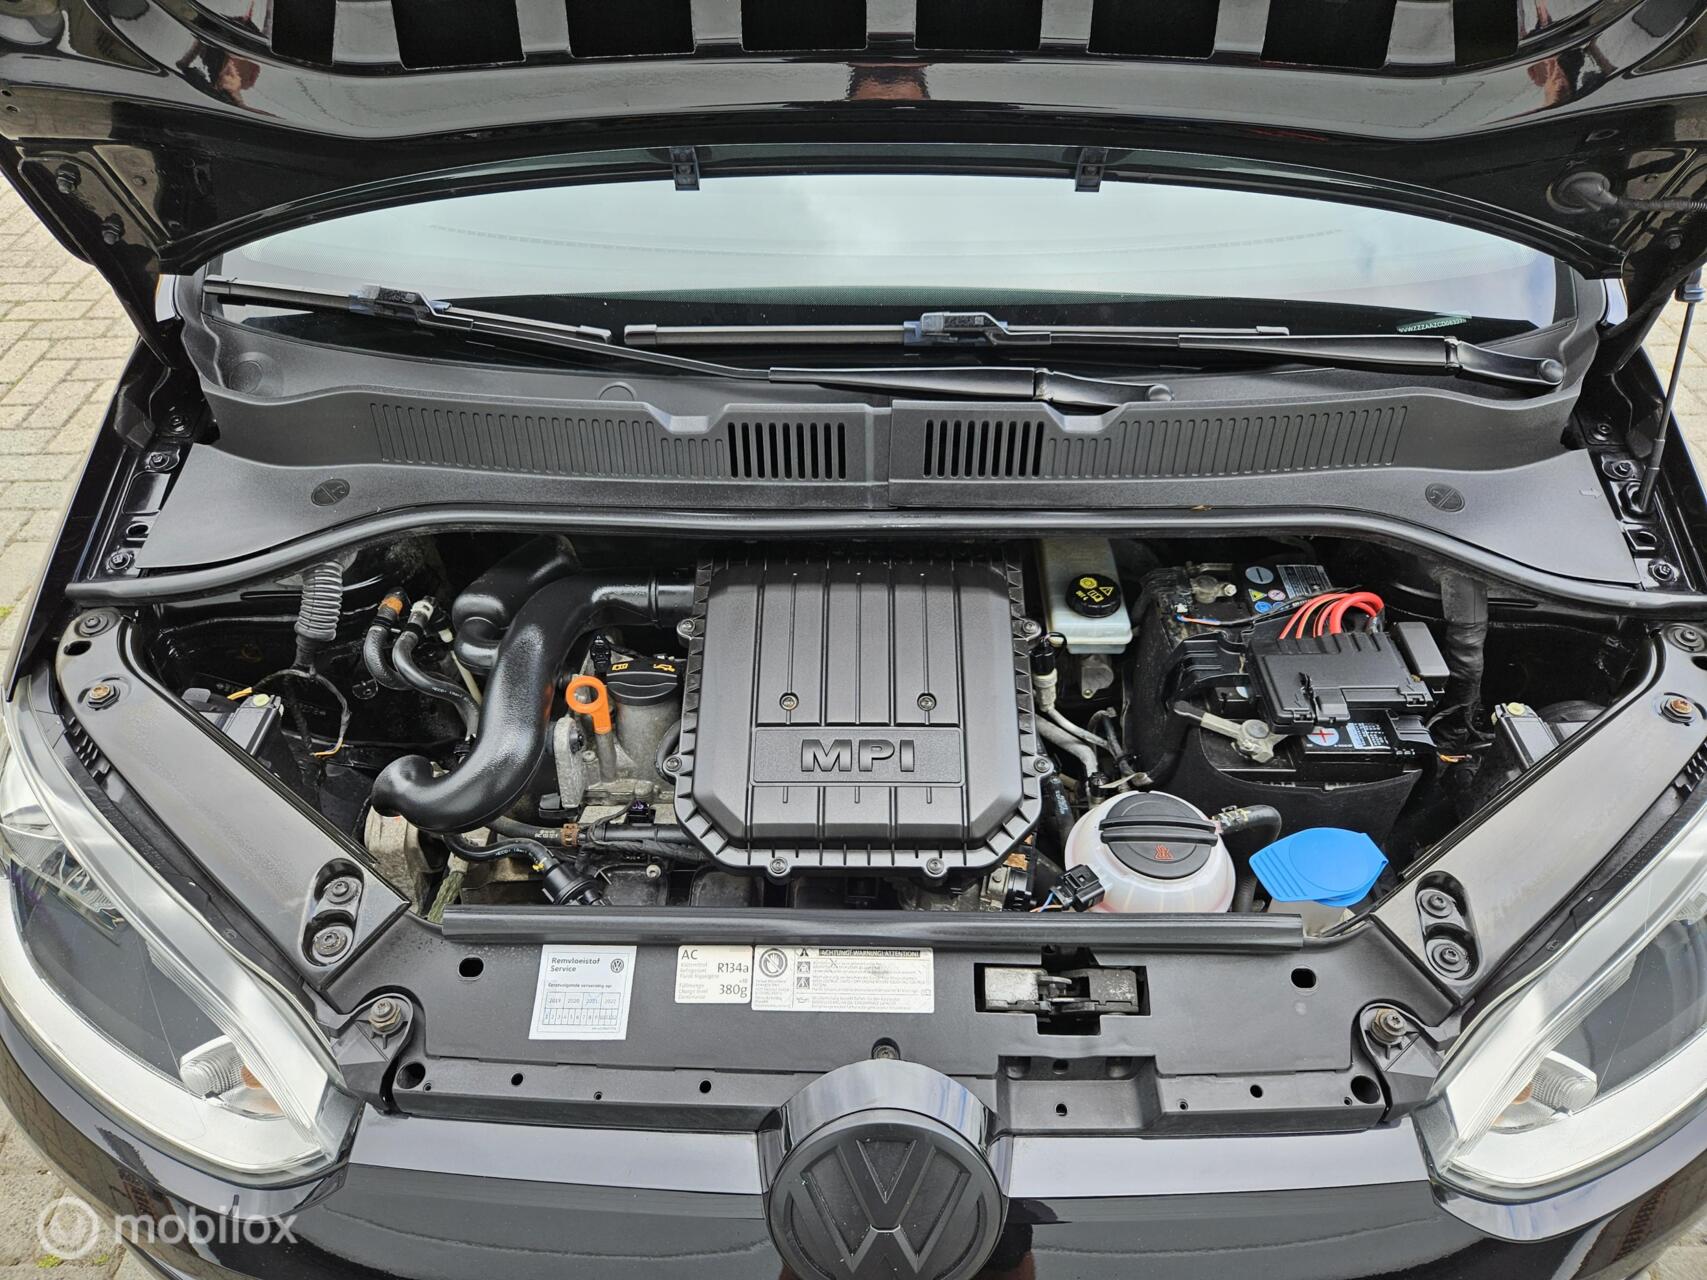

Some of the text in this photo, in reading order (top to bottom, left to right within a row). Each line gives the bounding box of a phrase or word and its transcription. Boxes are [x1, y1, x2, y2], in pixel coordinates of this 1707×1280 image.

[801, 739, 915, 772] MPI
[681, 949, 698, 960] AC
[551, 957, 600, 965] Remvloeistof
[717, 962, 749, 974] R134a
[719, 983, 748, 999] 380g
